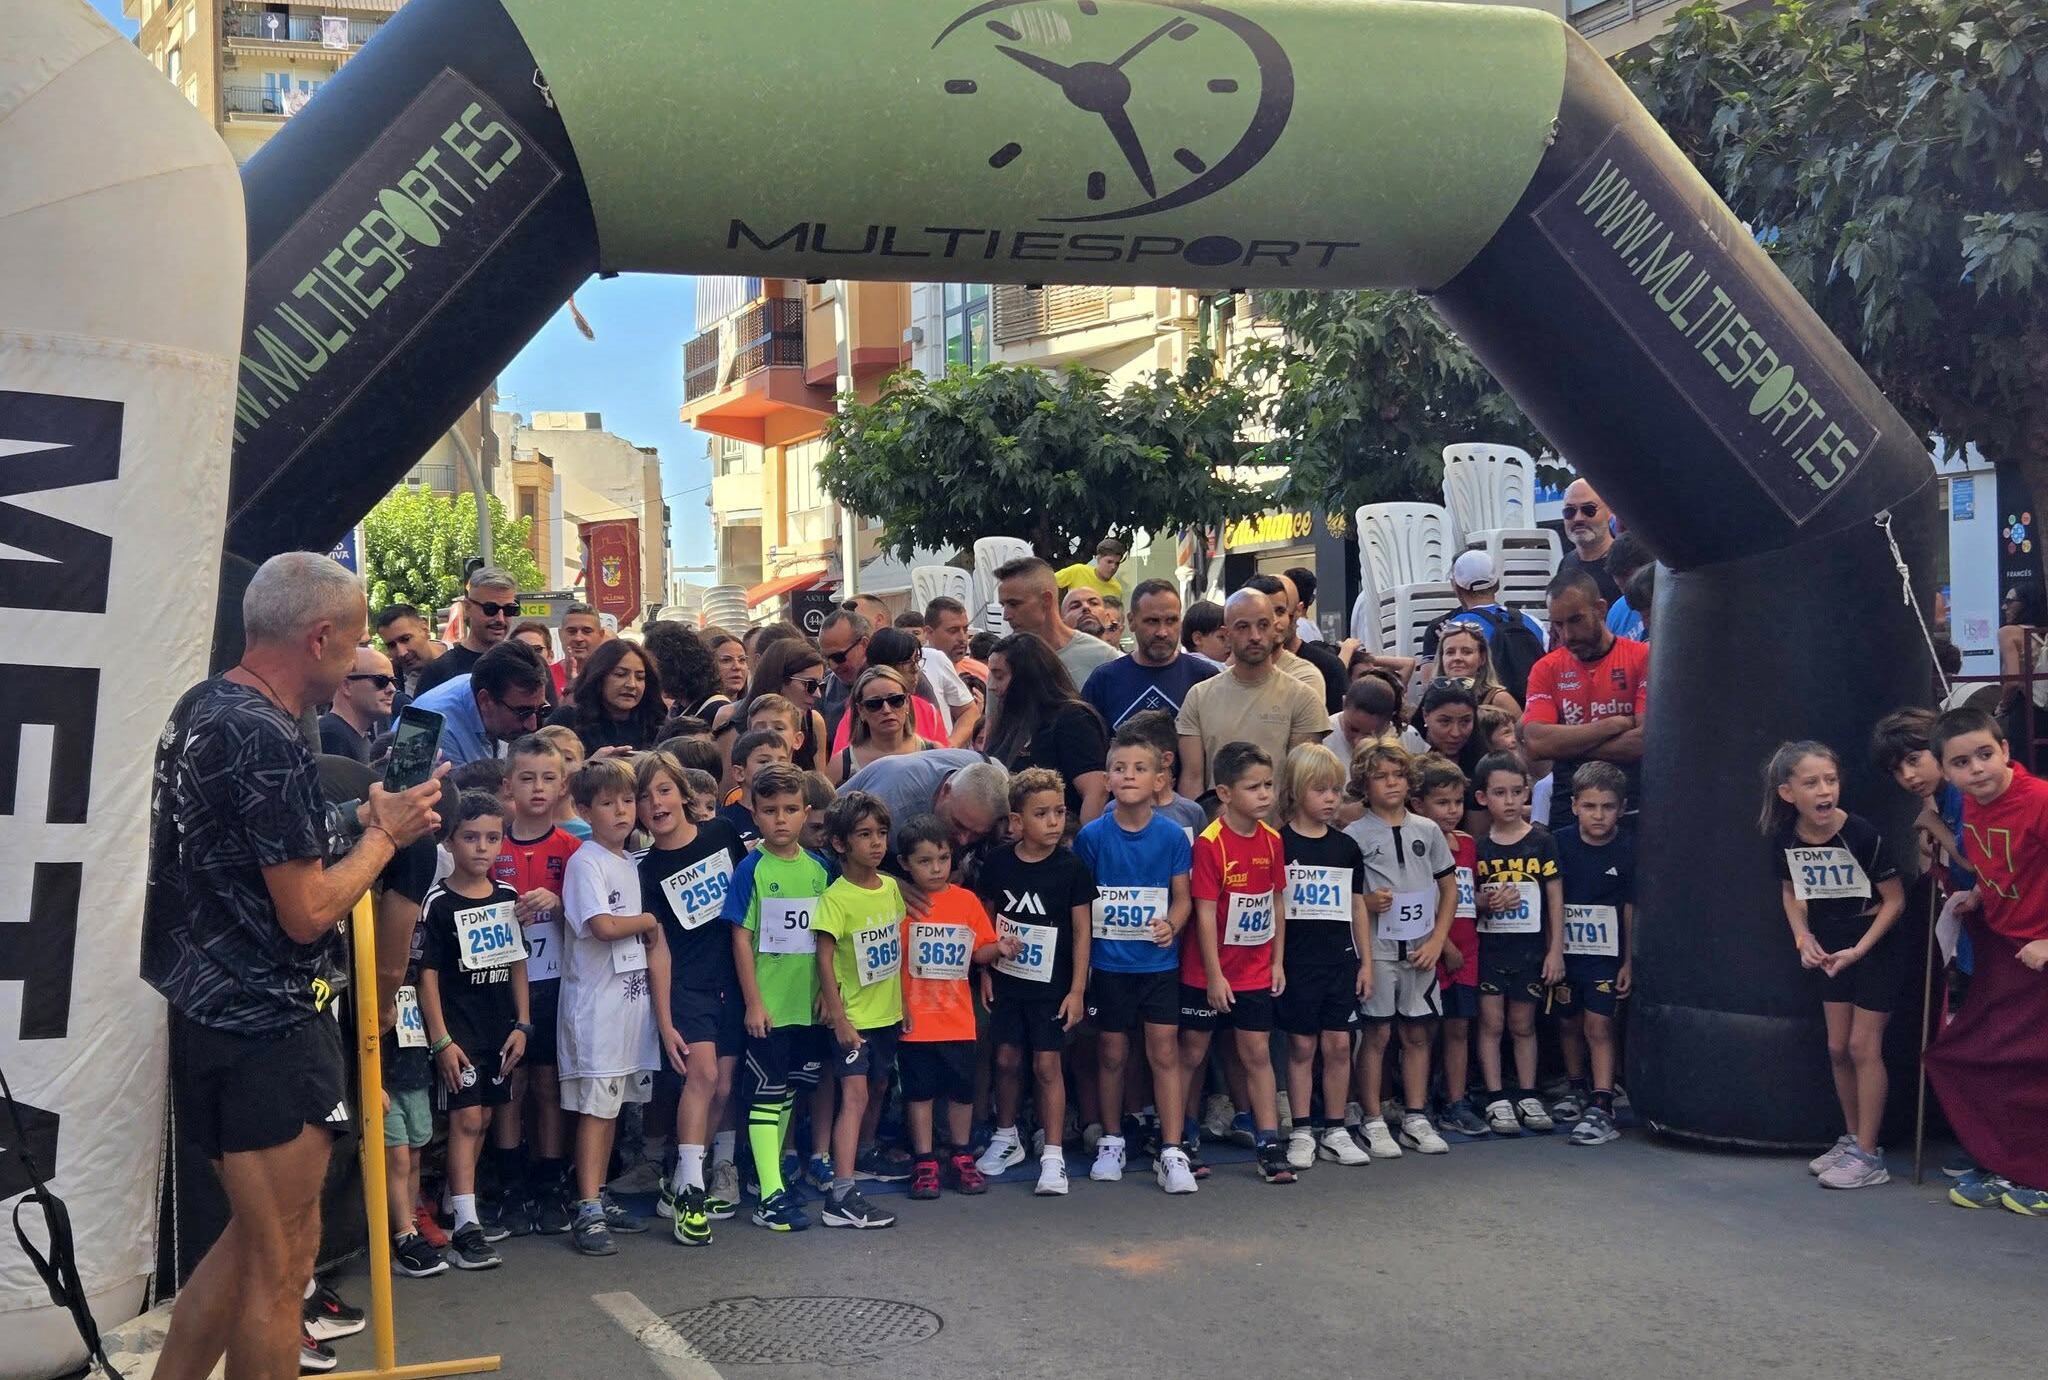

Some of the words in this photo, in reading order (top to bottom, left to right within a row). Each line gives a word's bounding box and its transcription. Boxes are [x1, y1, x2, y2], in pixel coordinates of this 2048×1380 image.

[726, 218, 1361, 267] MULTIESPORT
[233, 102, 522, 444] W.MULTIESPORT.ES
[1575, 158, 1859, 491] WWW.MULTIESPORT.ES
[520, 605, 545, 615] NCE
[1591, 699, 1633, 716] Pedro
[1793, 851, 1823, 861] FDM
[1290, 869, 1316, 880] FDM
[1477, 858, 1558, 877] ATMAN
[1802, 864, 1854, 886] 3717
[670, 868, 699, 890] FDM
[680, 871, 729, 914] 2559
[1101, 890, 1129, 901] FDM
[1238, 897, 1264, 908] FDM
[1293, 883, 1341, 907] 4921
[461, 911, 489, 926] FDM
[784, 910, 810, 930] 50
[1103, 905, 1156, 928] 2597
[1238, 909, 1273, 932] 482
[1400, 904, 1423, 922] 53
[1566, 909, 1584, 918] DM
[468, 922, 513, 954] 2564
[860, 927, 888, 943] FDM
[916, 926, 945, 938] FDM
[1564, 922, 1608, 943] 1791
[866, 937, 899, 969] 369
[919, 942, 966, 966] 3632
[1006, 942, 1043, 967] 35
[403, 1005, 422, 1031] 49
